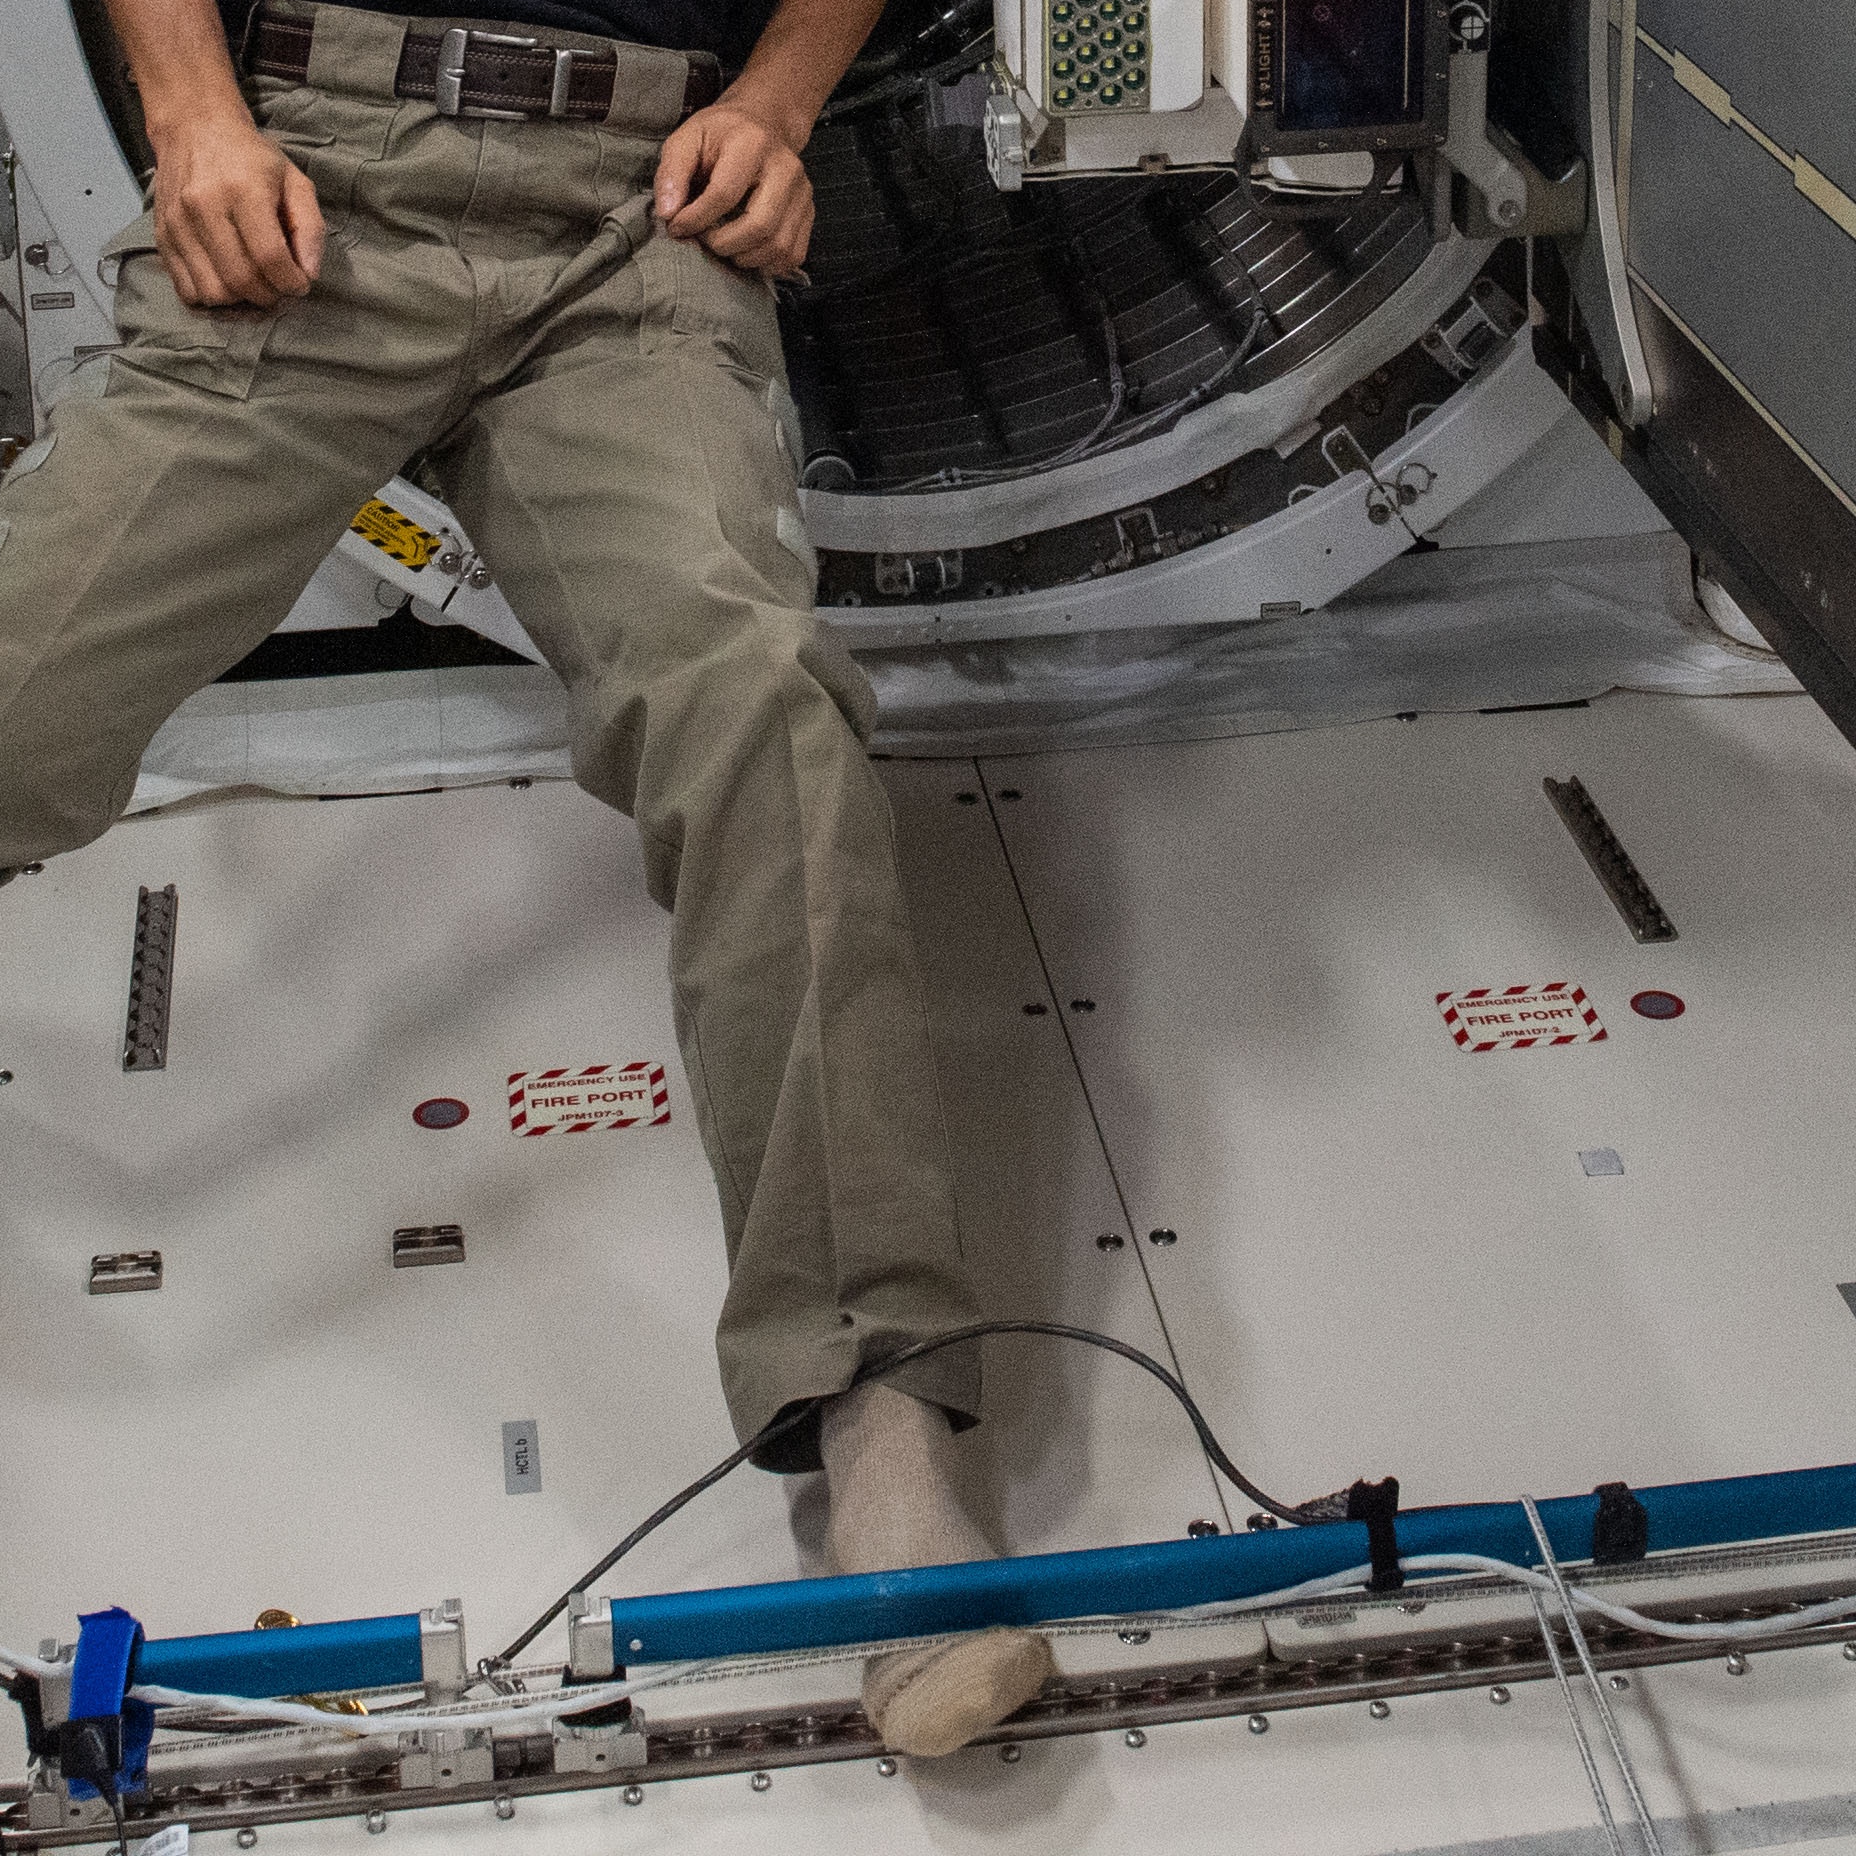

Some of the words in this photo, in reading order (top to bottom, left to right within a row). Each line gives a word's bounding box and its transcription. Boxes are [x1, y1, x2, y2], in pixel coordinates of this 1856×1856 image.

[1258, 32, 1271, 85] LIGHT
[366, 506, 400, 532] CAUTION
[1456, 995, 1539, 1009] EMERGENCY
[1541, 992, 1569, 1002] USE
[1465, 1012, 1515, 1026] FIRE
[1518, 1007, 1574, 1022] PORT
[1498, 1026, 1560, 1038] JPM1D7-2
[527, 1075, 614, 1091] EMERGENCY
[618, 1072, 647, 1083] USE
[530, 1094, 581, 1109] FIRE
[586, 1089, 647, 1104] PORT
[557, 1109, 624, 1122] JPM1D7-3
[514, 1437, 528, 1446] b
[514, 1448, 529, 1476] HCTL
